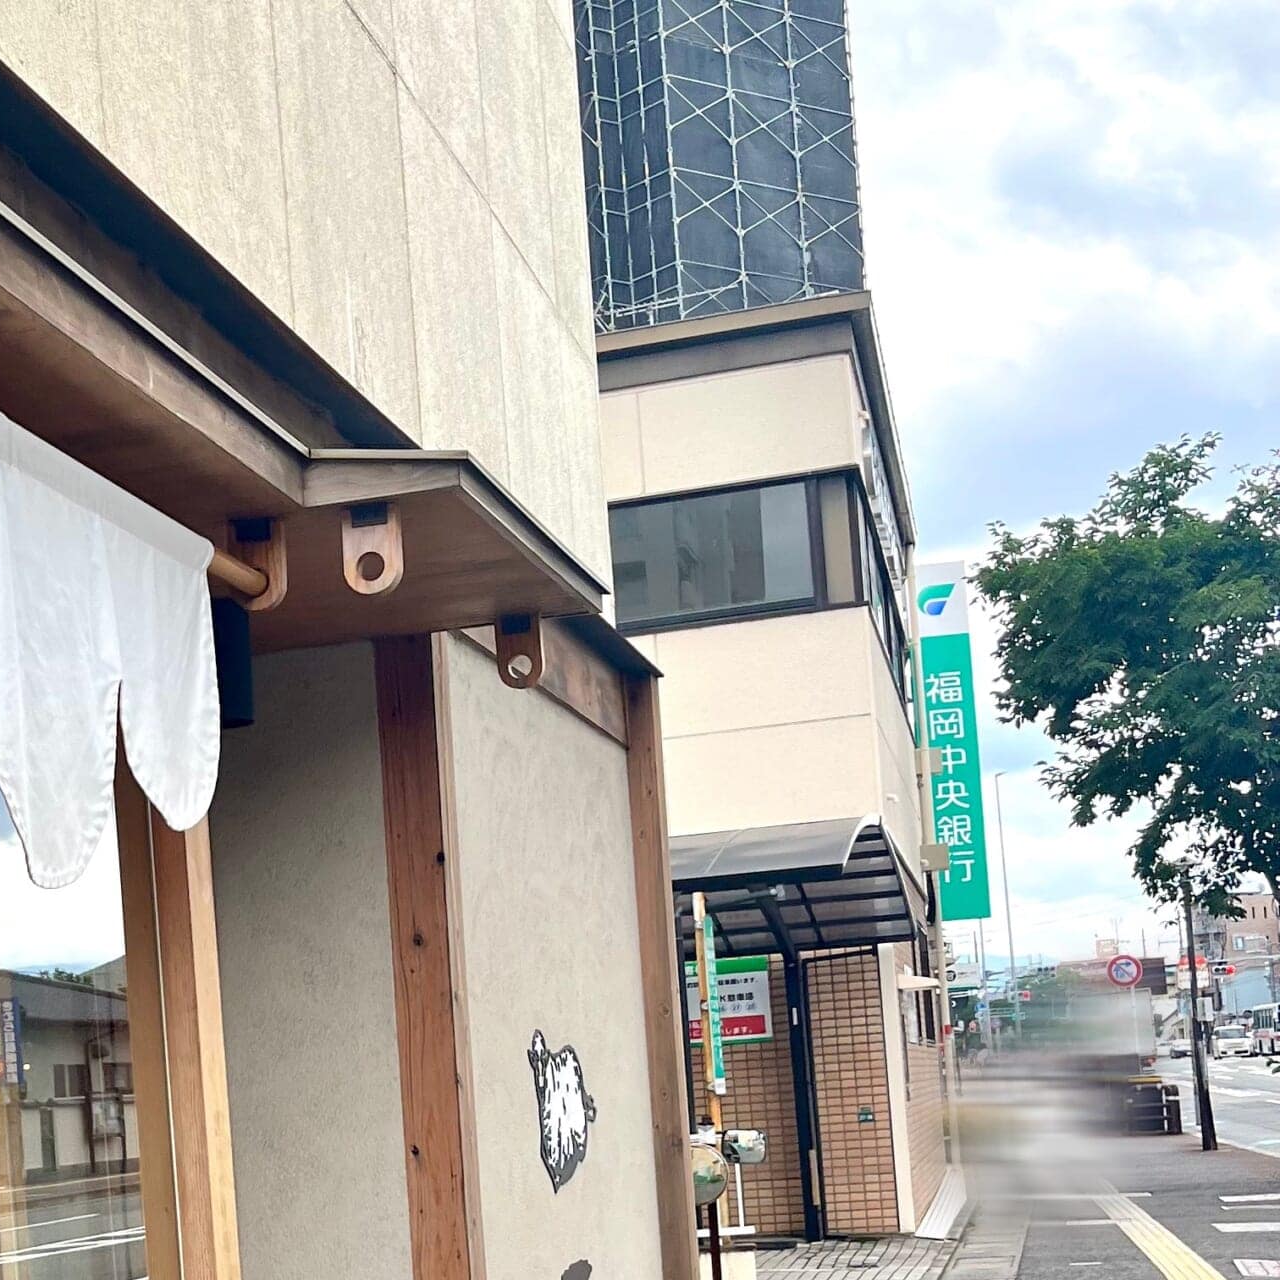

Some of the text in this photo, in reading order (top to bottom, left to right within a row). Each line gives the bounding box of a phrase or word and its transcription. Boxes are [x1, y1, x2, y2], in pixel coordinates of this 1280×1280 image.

[926, 670, 975, 883] 福岡中央銀行
